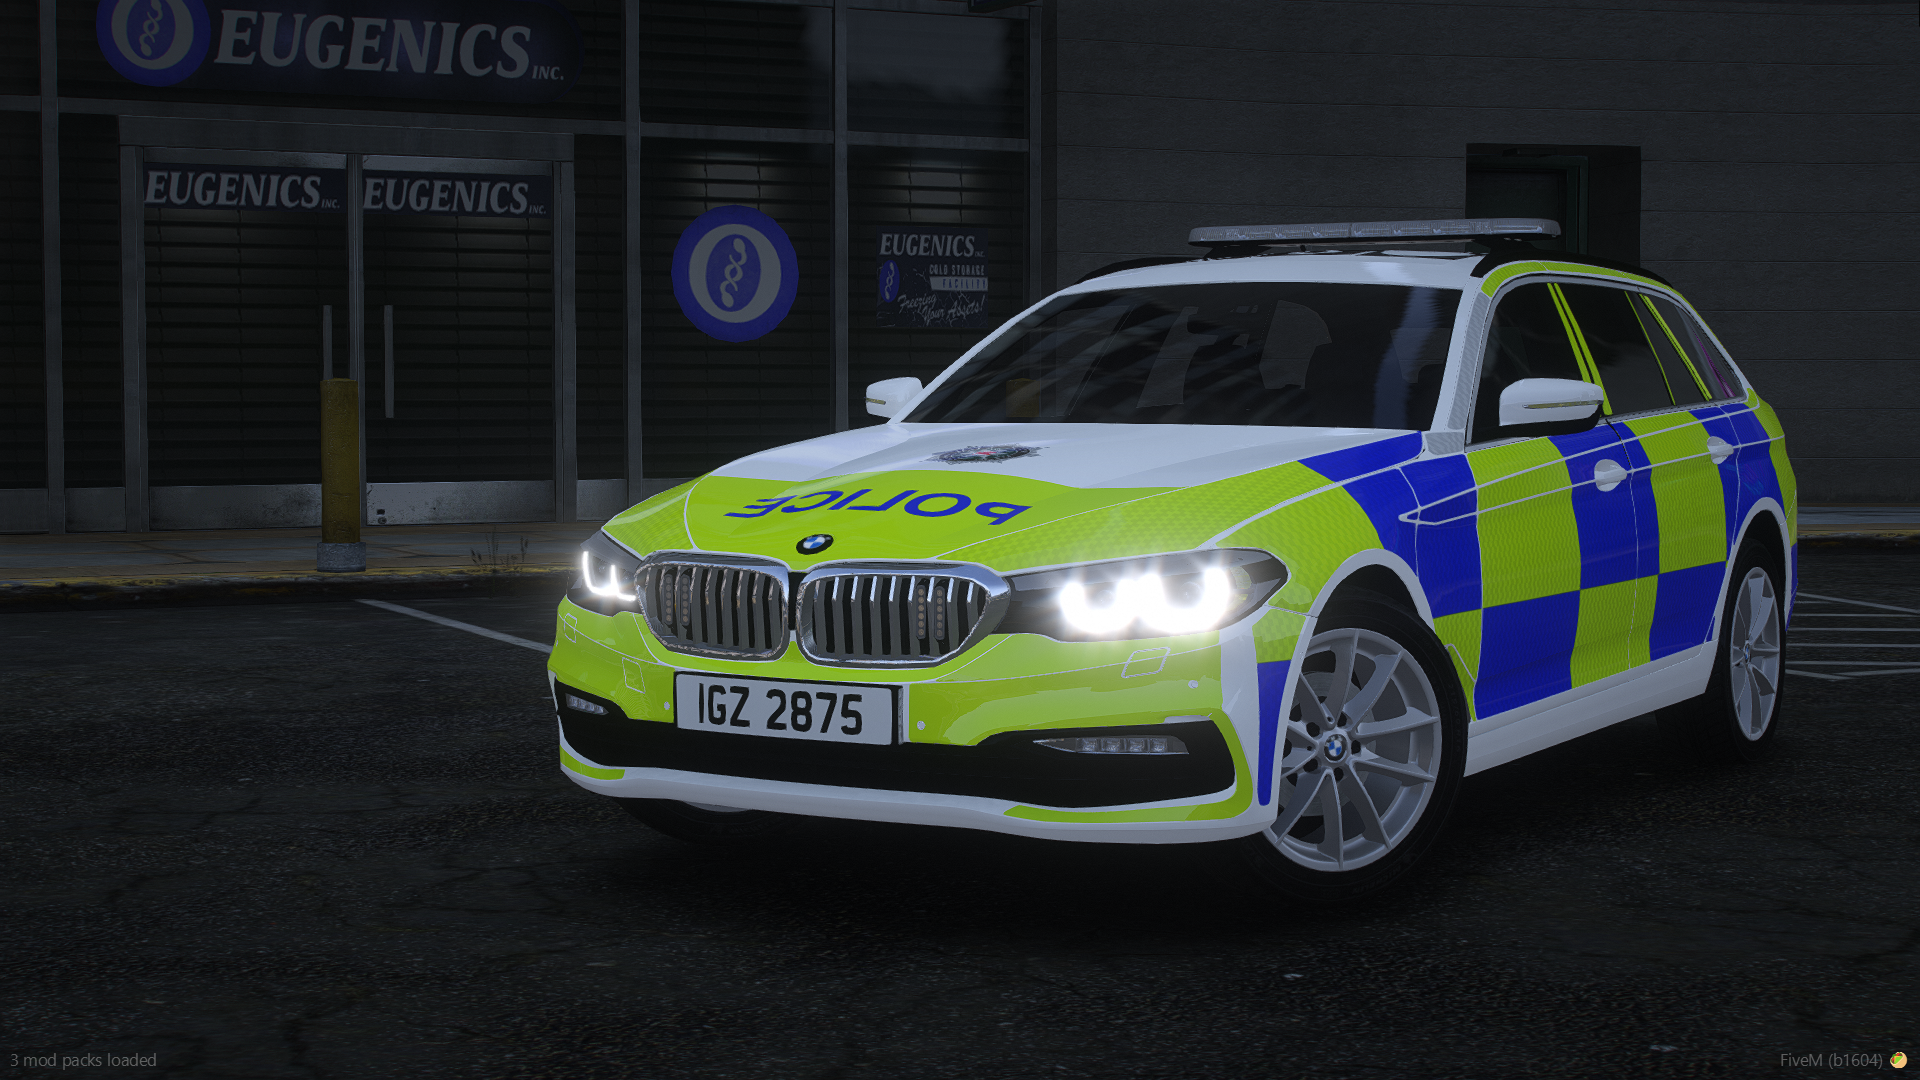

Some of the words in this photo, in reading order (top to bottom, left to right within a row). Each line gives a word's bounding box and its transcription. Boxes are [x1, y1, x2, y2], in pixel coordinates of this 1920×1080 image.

[213, 9, 532, 79] EUGENICS
[532, 64, 565, 81] INC.
[145, 170, 322, 210] EUGENICS
[362, 177, 529, 215] EUGENICS
[879, 233, 975, 258] EUGENICS
[929, 263, 948, 276] COLD
[951, 264, 985, 276] STORAGE
[698, 682, 751, 728] IGZ
[765, 688, 863, 736] 2875
